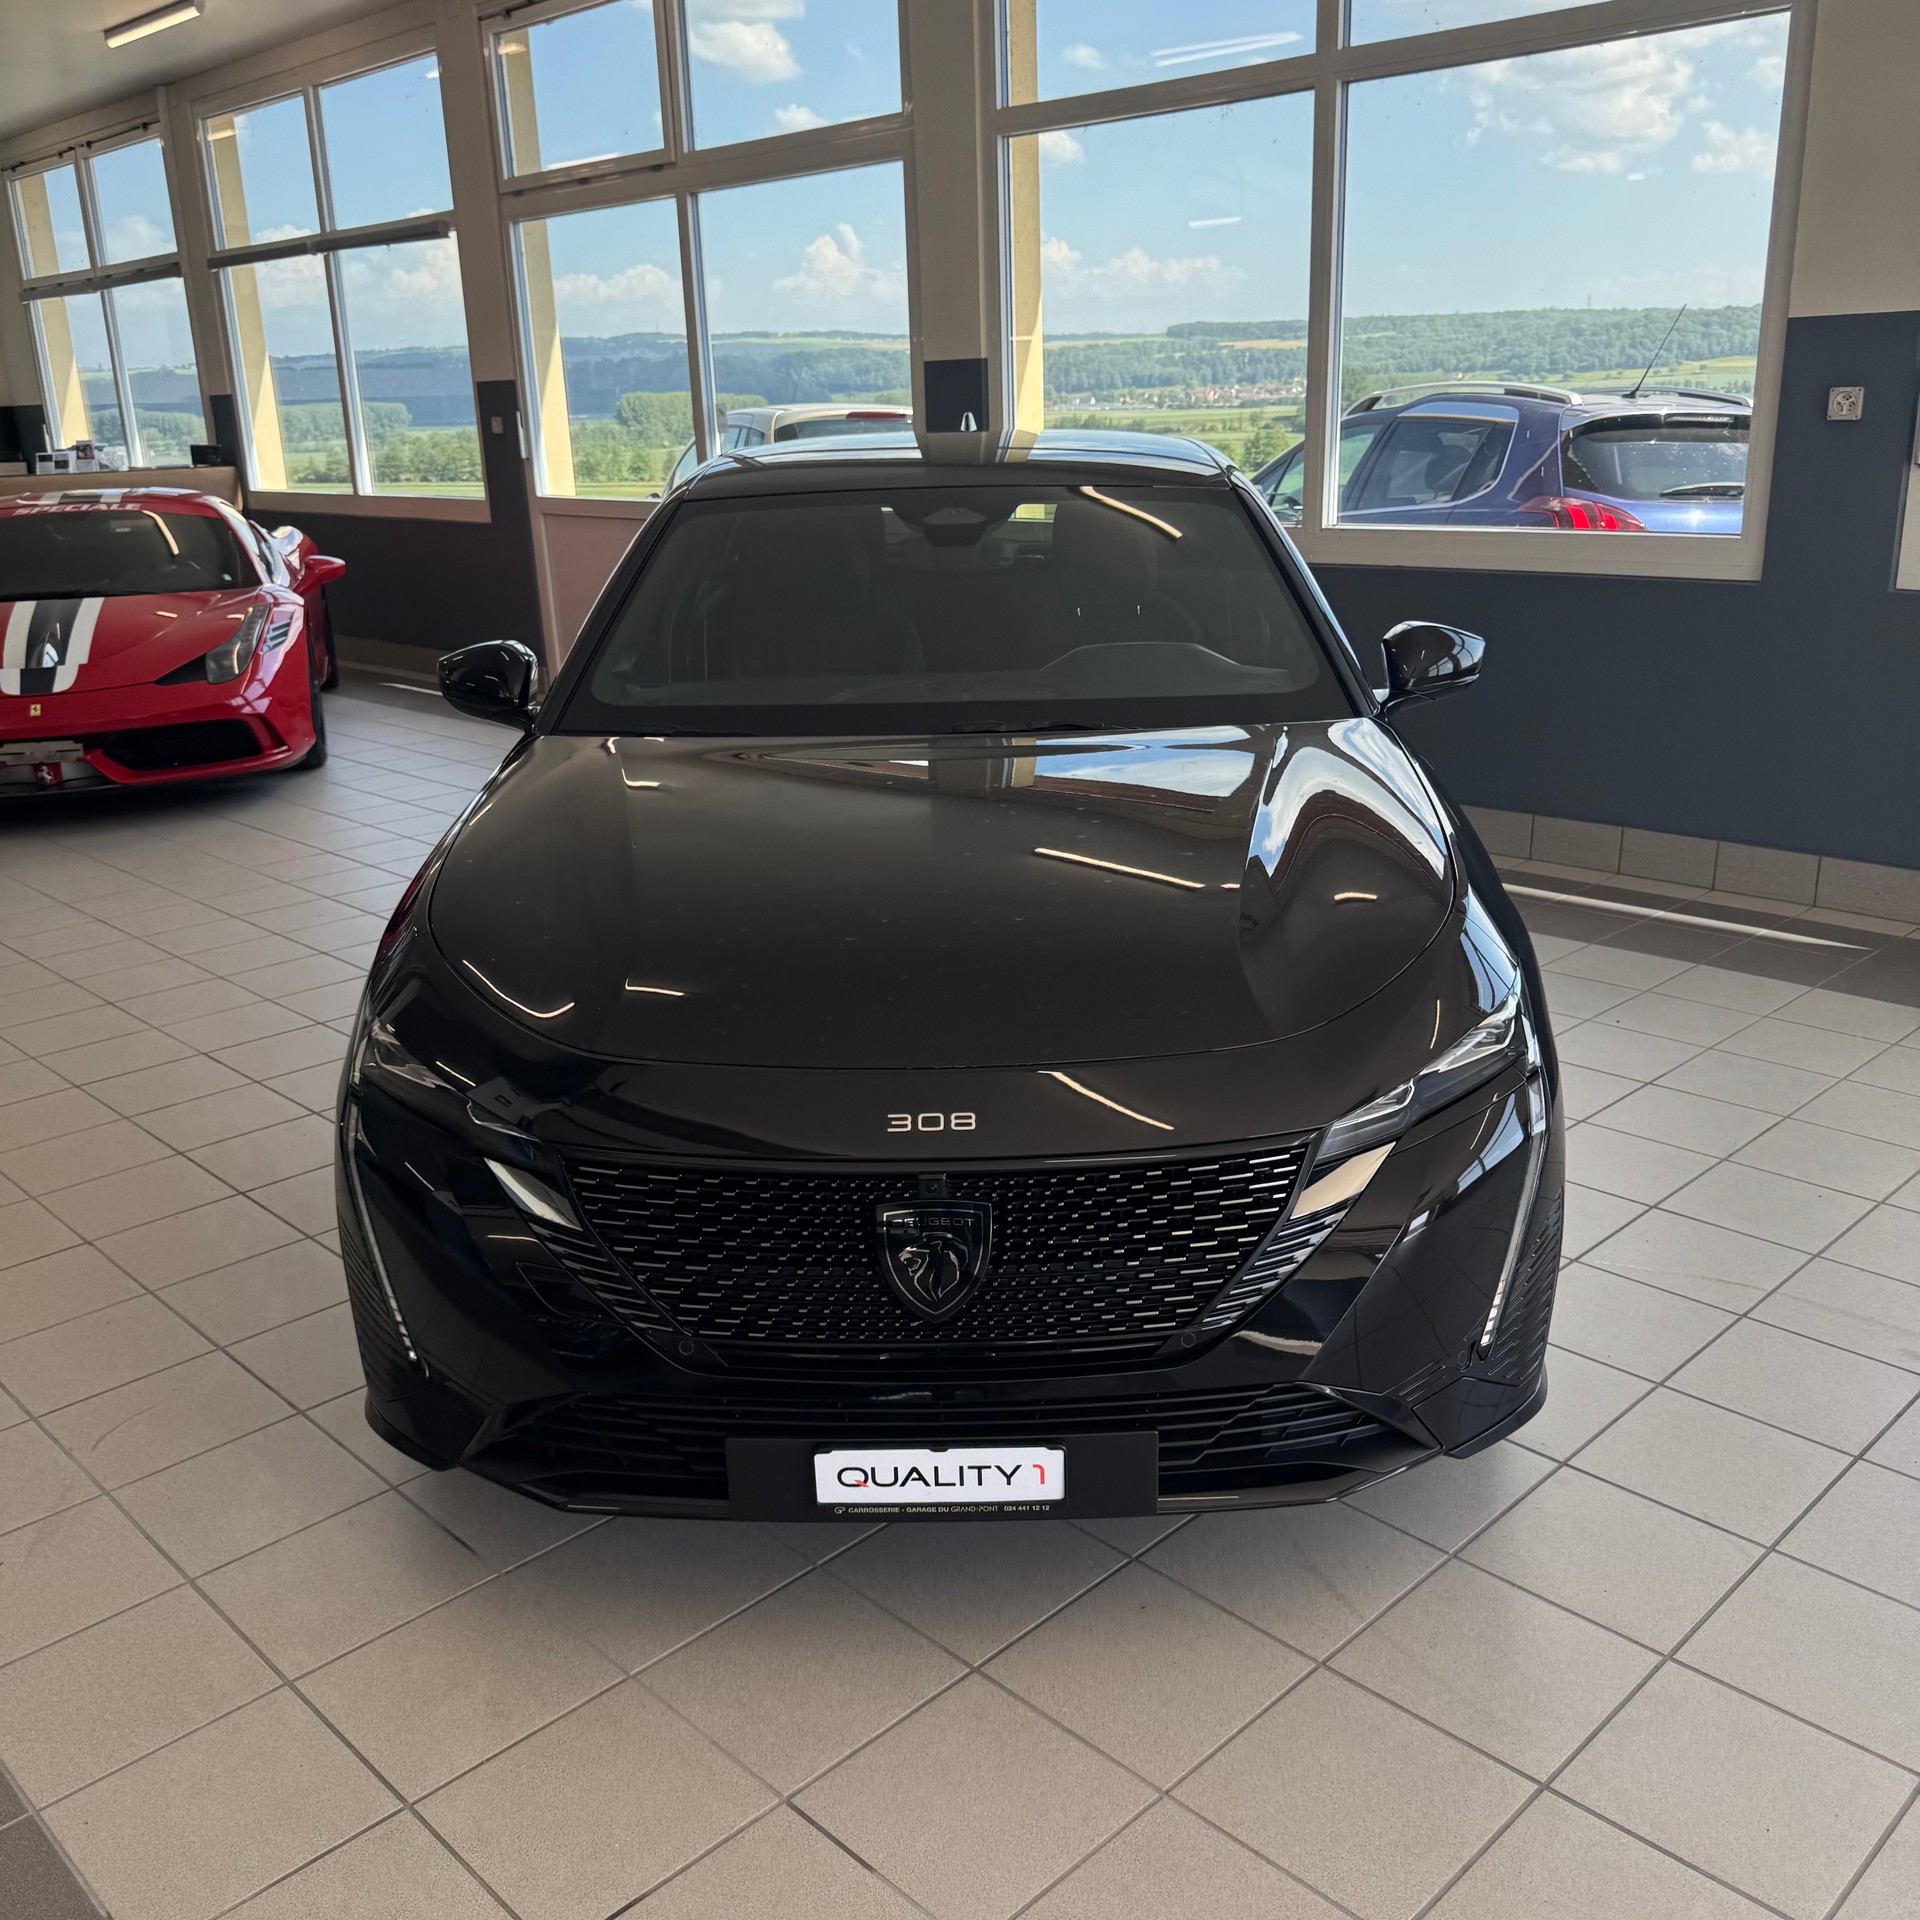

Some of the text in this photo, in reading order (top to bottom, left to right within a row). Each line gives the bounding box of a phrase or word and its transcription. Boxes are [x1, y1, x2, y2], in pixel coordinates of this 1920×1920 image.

[12, 502, 142, 516] SPECIALE
[887, 1112, 976, 1132] 308
[837, 1464, 1046, 1488] QUALITY 1
[848, 1506, 900, 1514] CARROSSERIE
